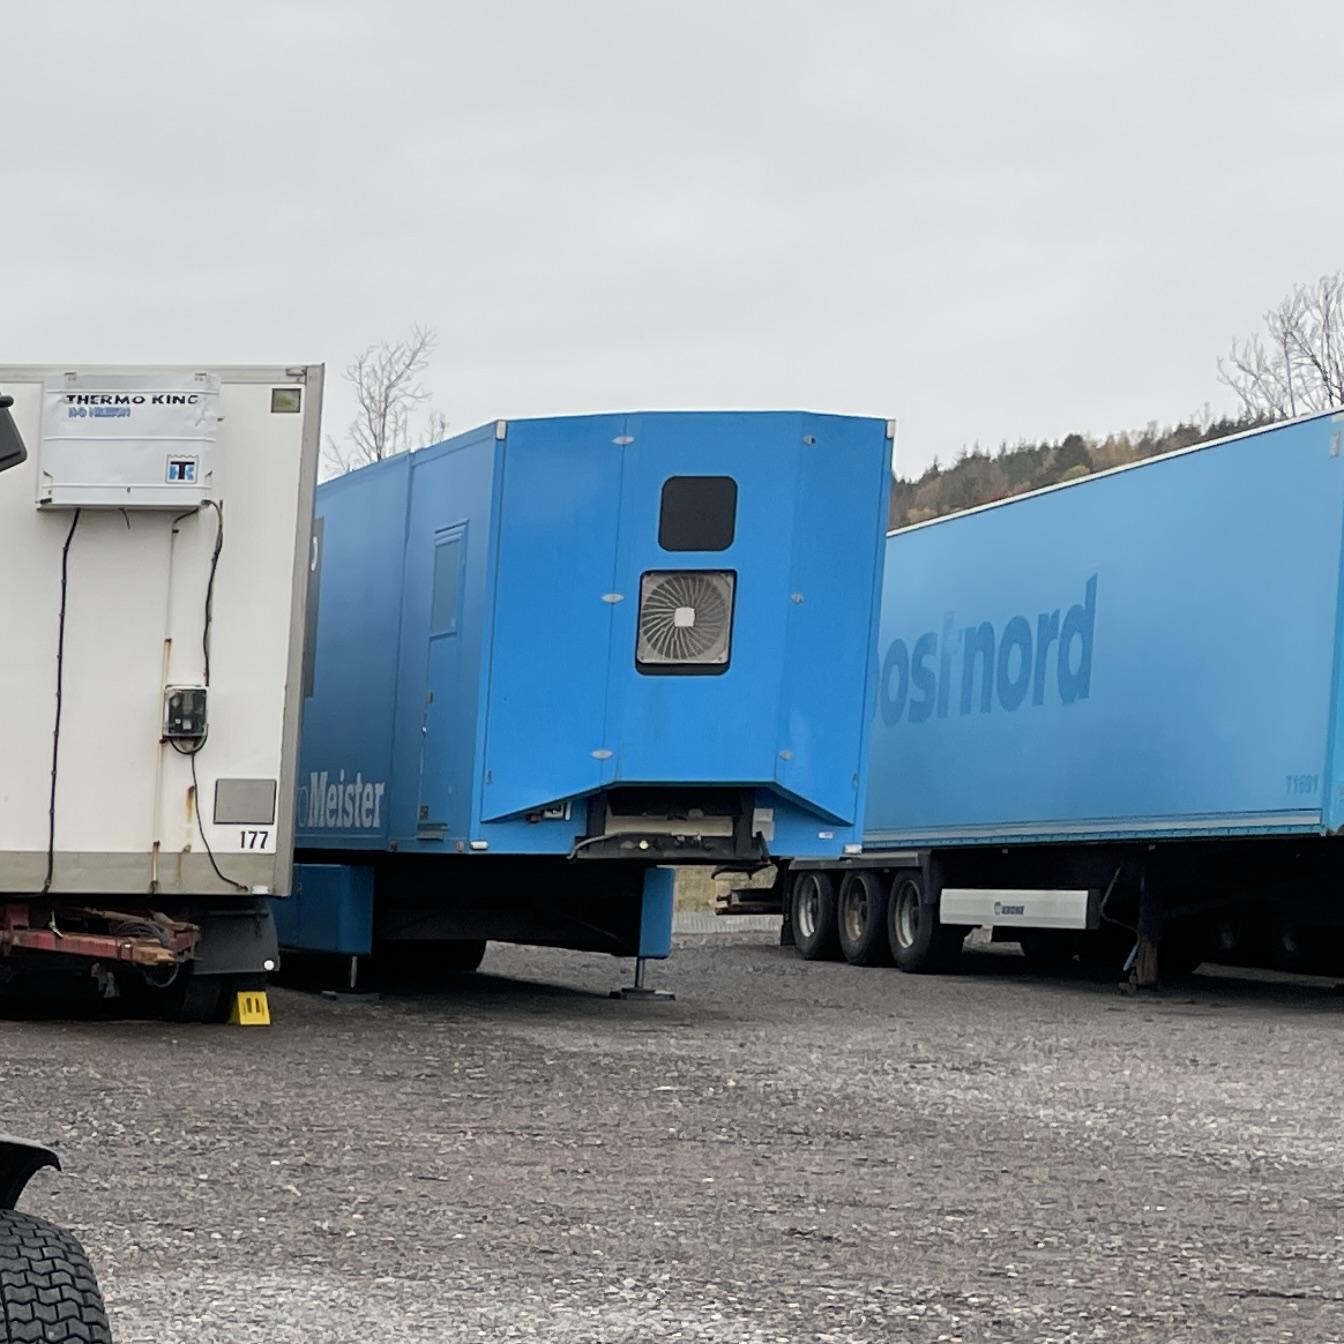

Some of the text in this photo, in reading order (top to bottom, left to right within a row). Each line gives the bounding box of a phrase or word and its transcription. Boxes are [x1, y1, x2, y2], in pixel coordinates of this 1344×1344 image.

[66, 394, 199, 405] THERMO KING
[875, 571, 1098, 728] ostnord
[240, 831, 269, 849] 177
